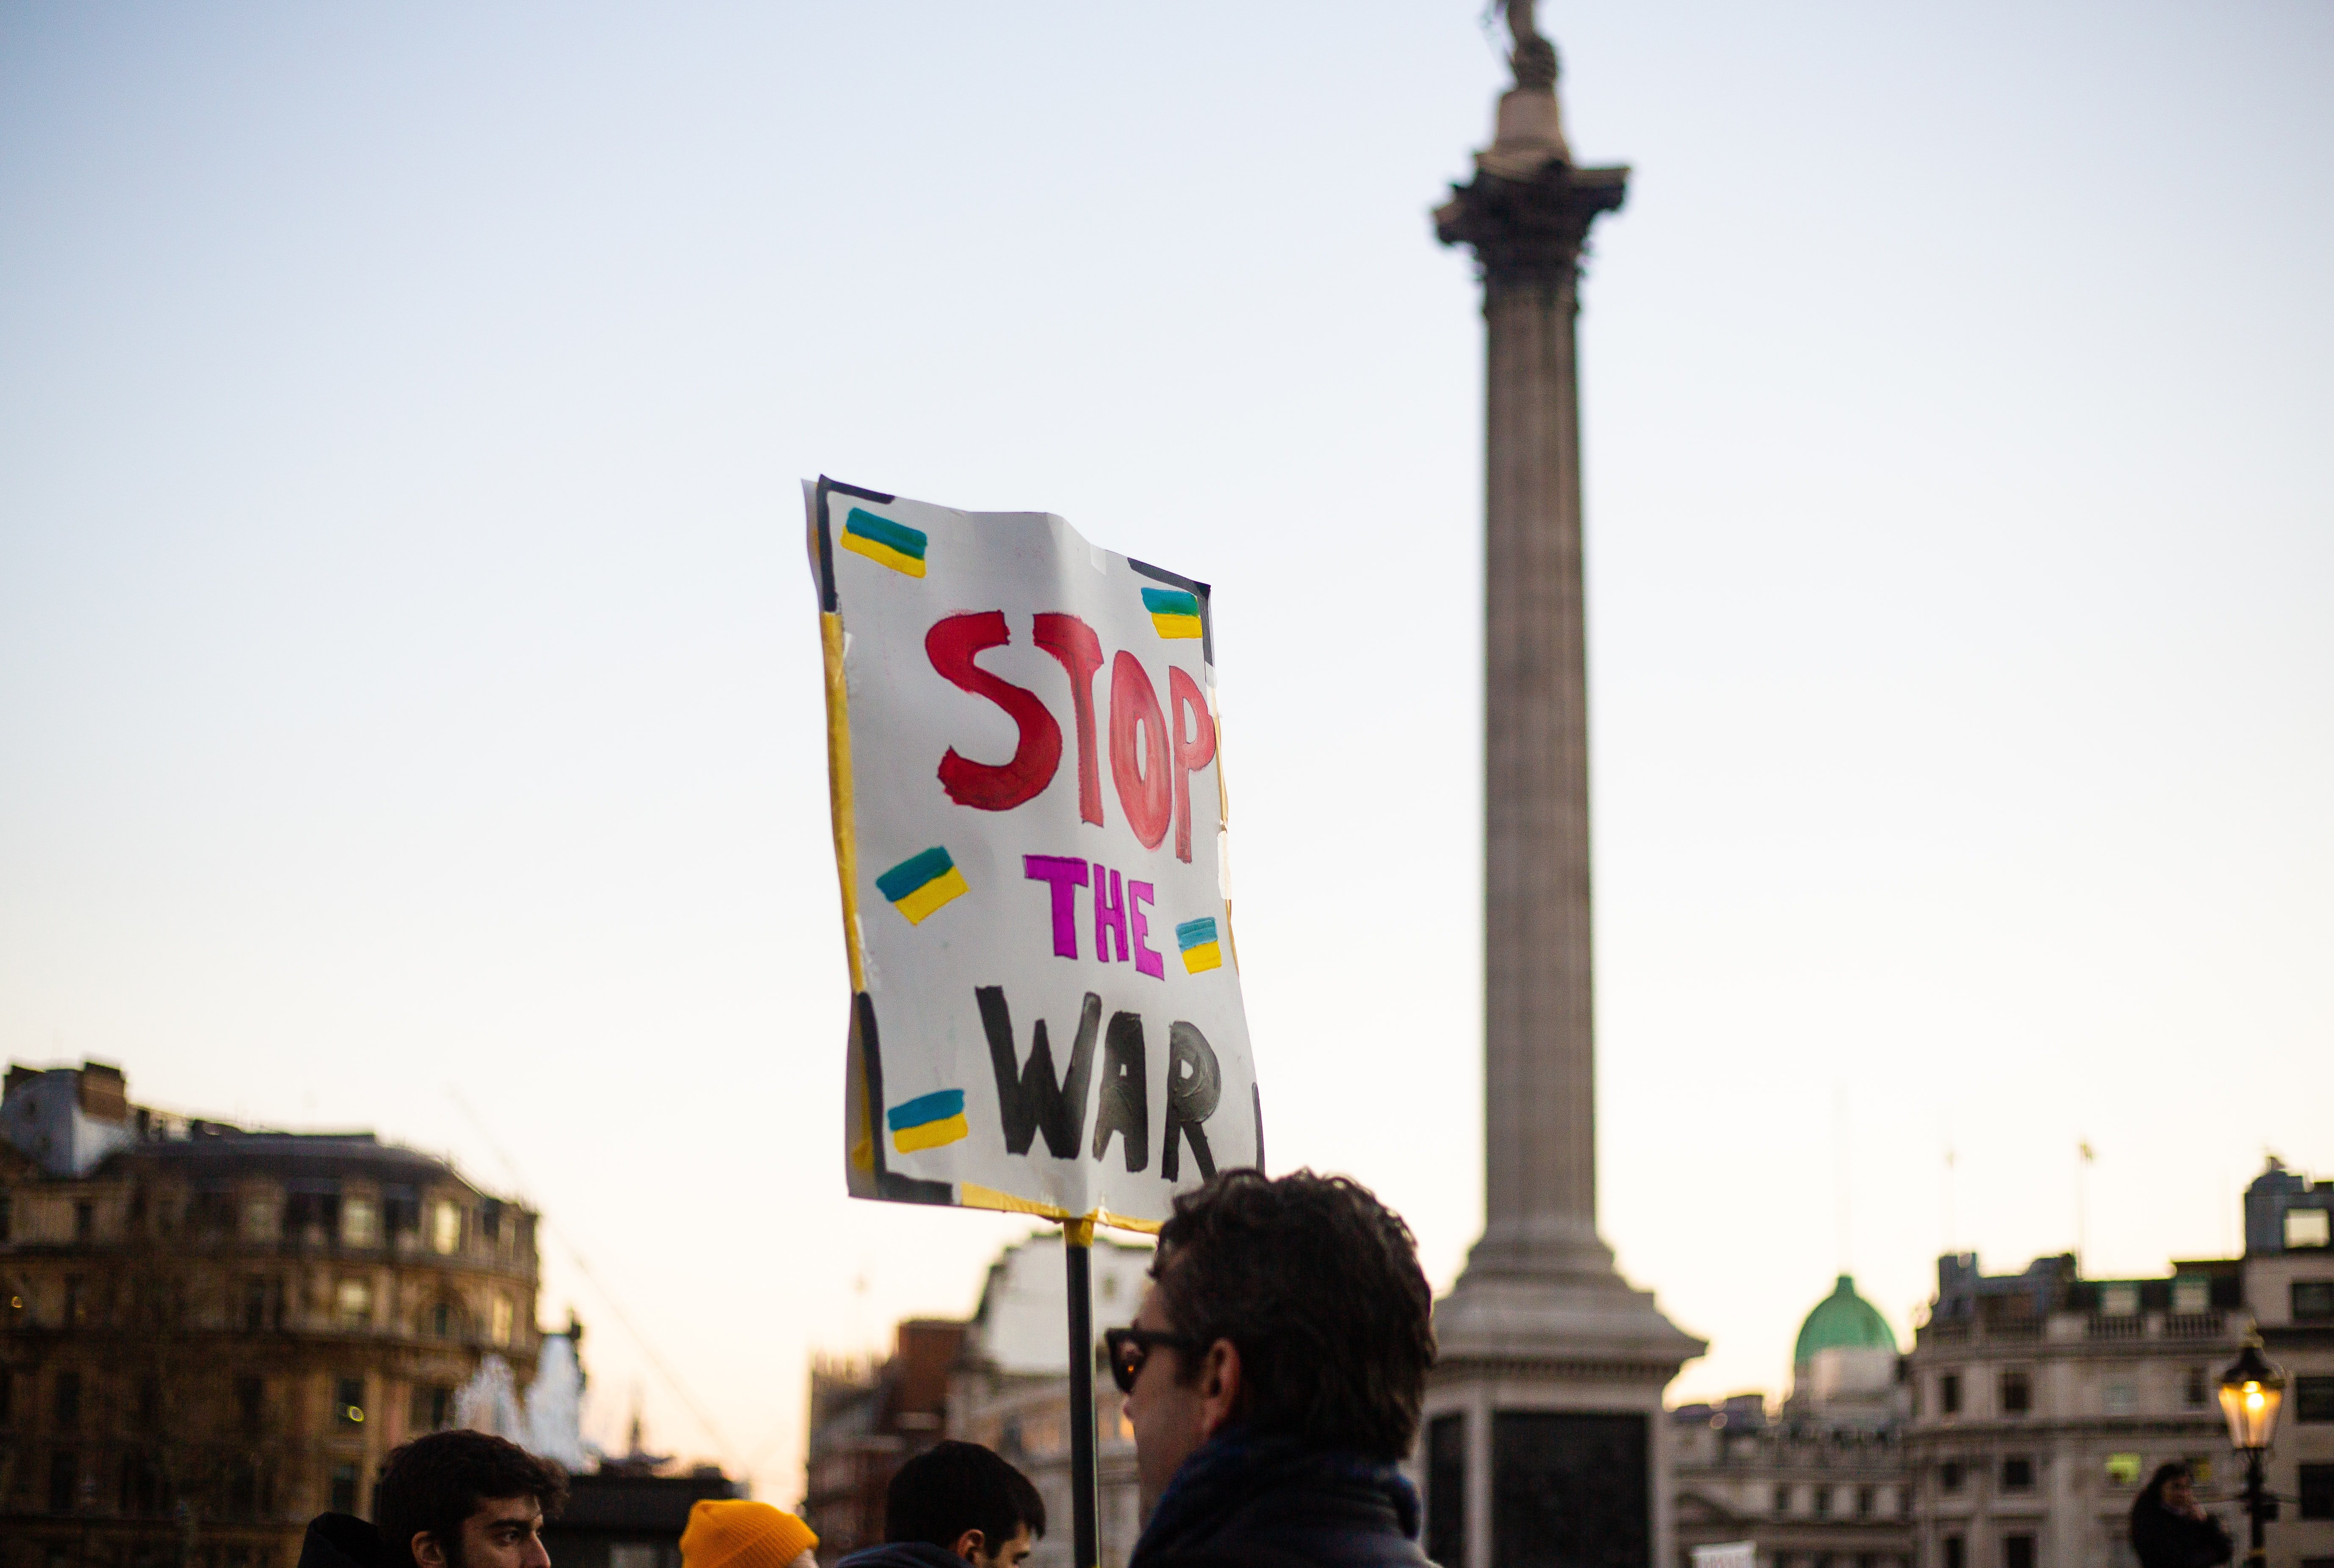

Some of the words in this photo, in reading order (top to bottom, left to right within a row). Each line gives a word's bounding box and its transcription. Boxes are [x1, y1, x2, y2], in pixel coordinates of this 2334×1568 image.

[925, 609, 1216, 864] STOP
[1022, 854, 1165, 981] THE
[974, 985, 1221, 1184] WAR
